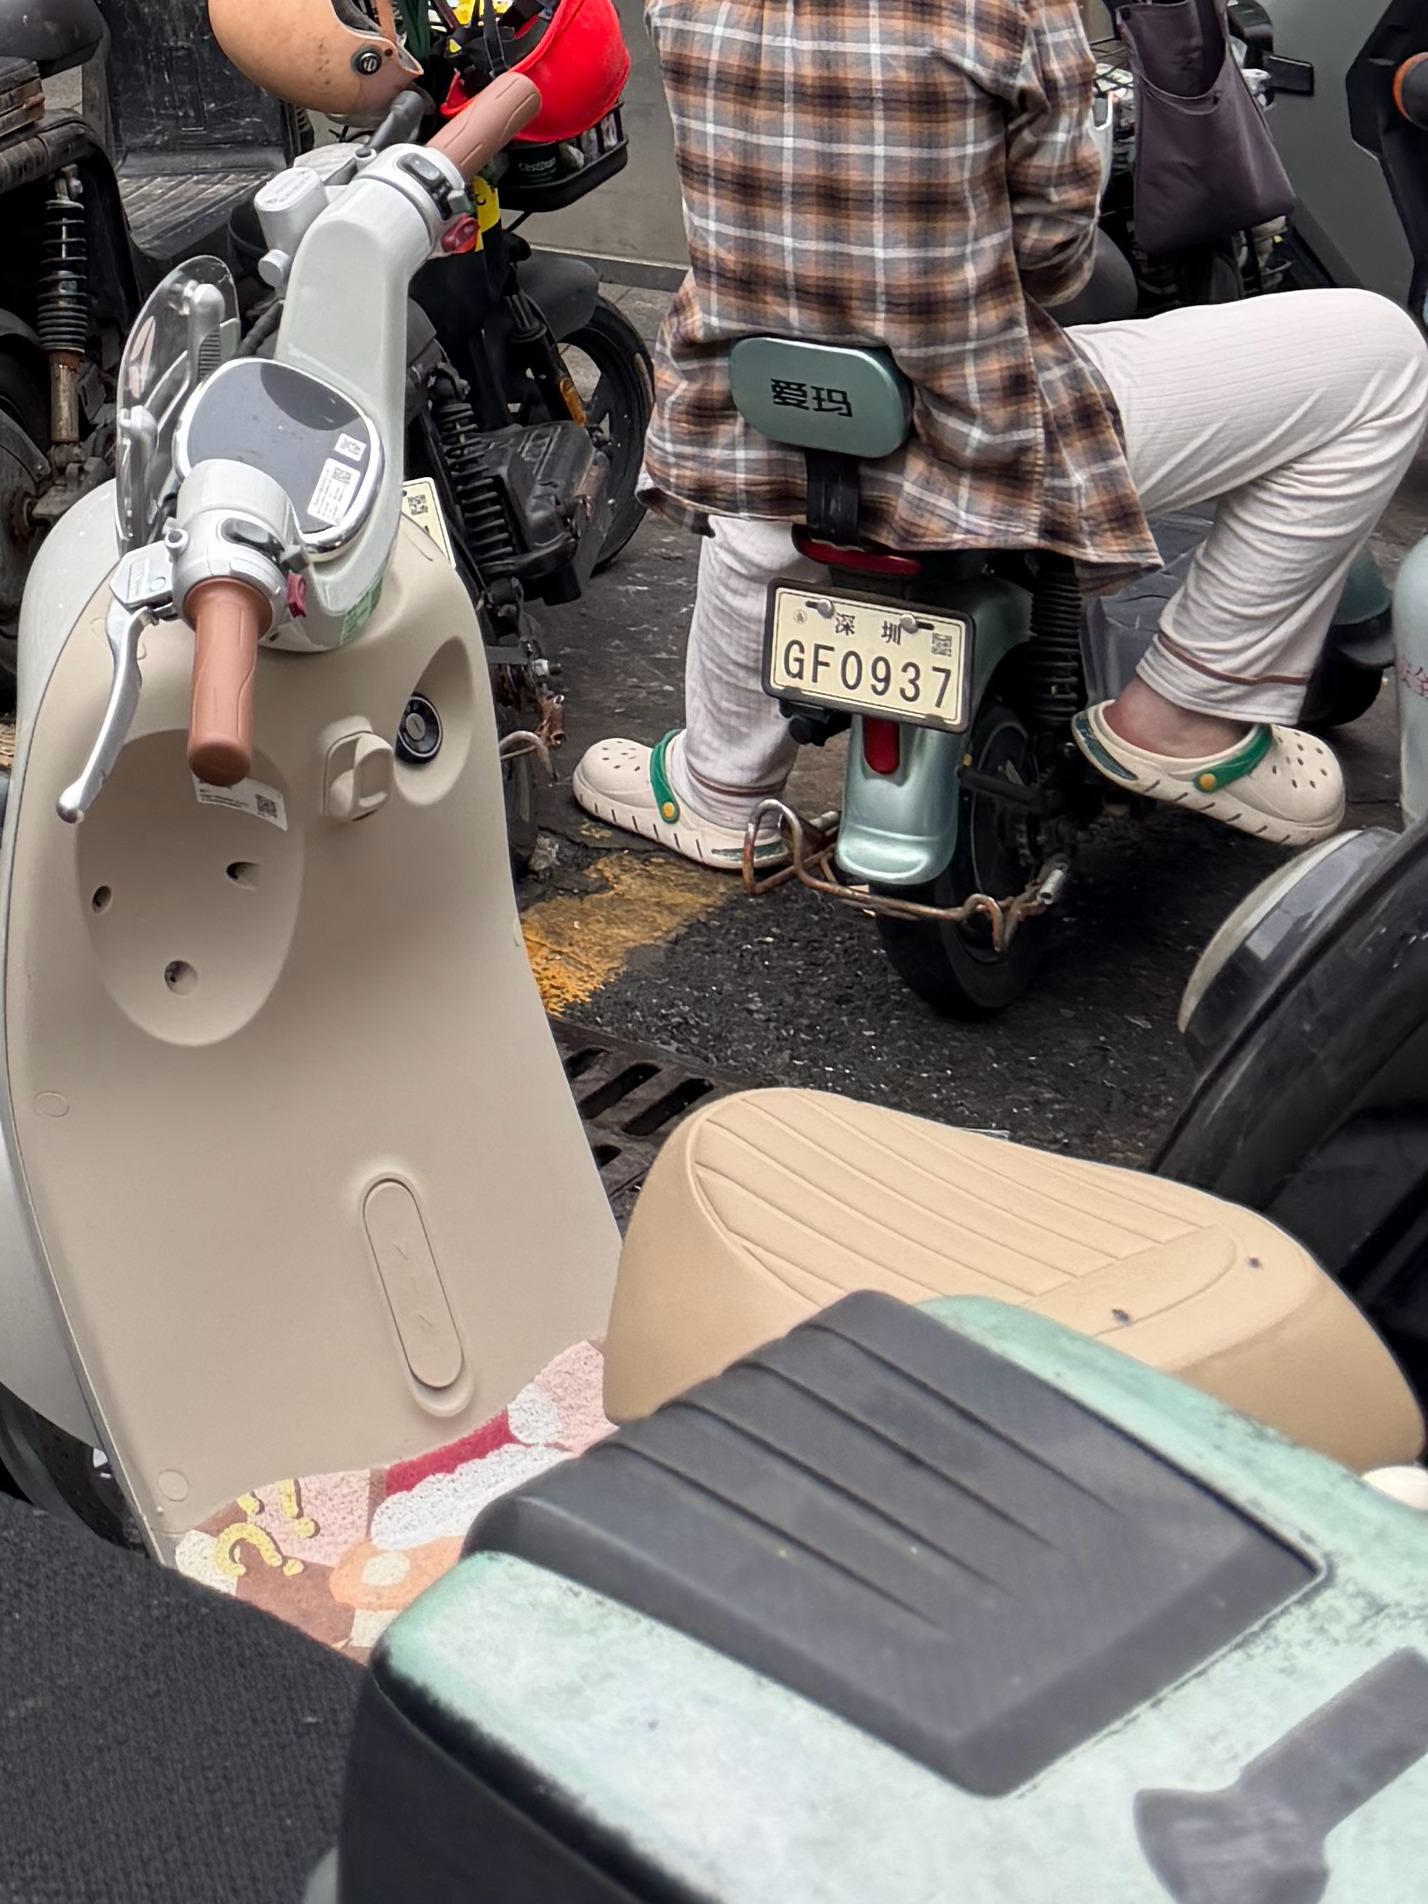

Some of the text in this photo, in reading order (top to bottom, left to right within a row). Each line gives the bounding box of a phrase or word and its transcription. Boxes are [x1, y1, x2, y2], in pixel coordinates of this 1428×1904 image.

[770, 378, 853, 418] 爱玛
[834, 611, 902, 647] 深圳
[782, 638, 952, 710] GF0937
